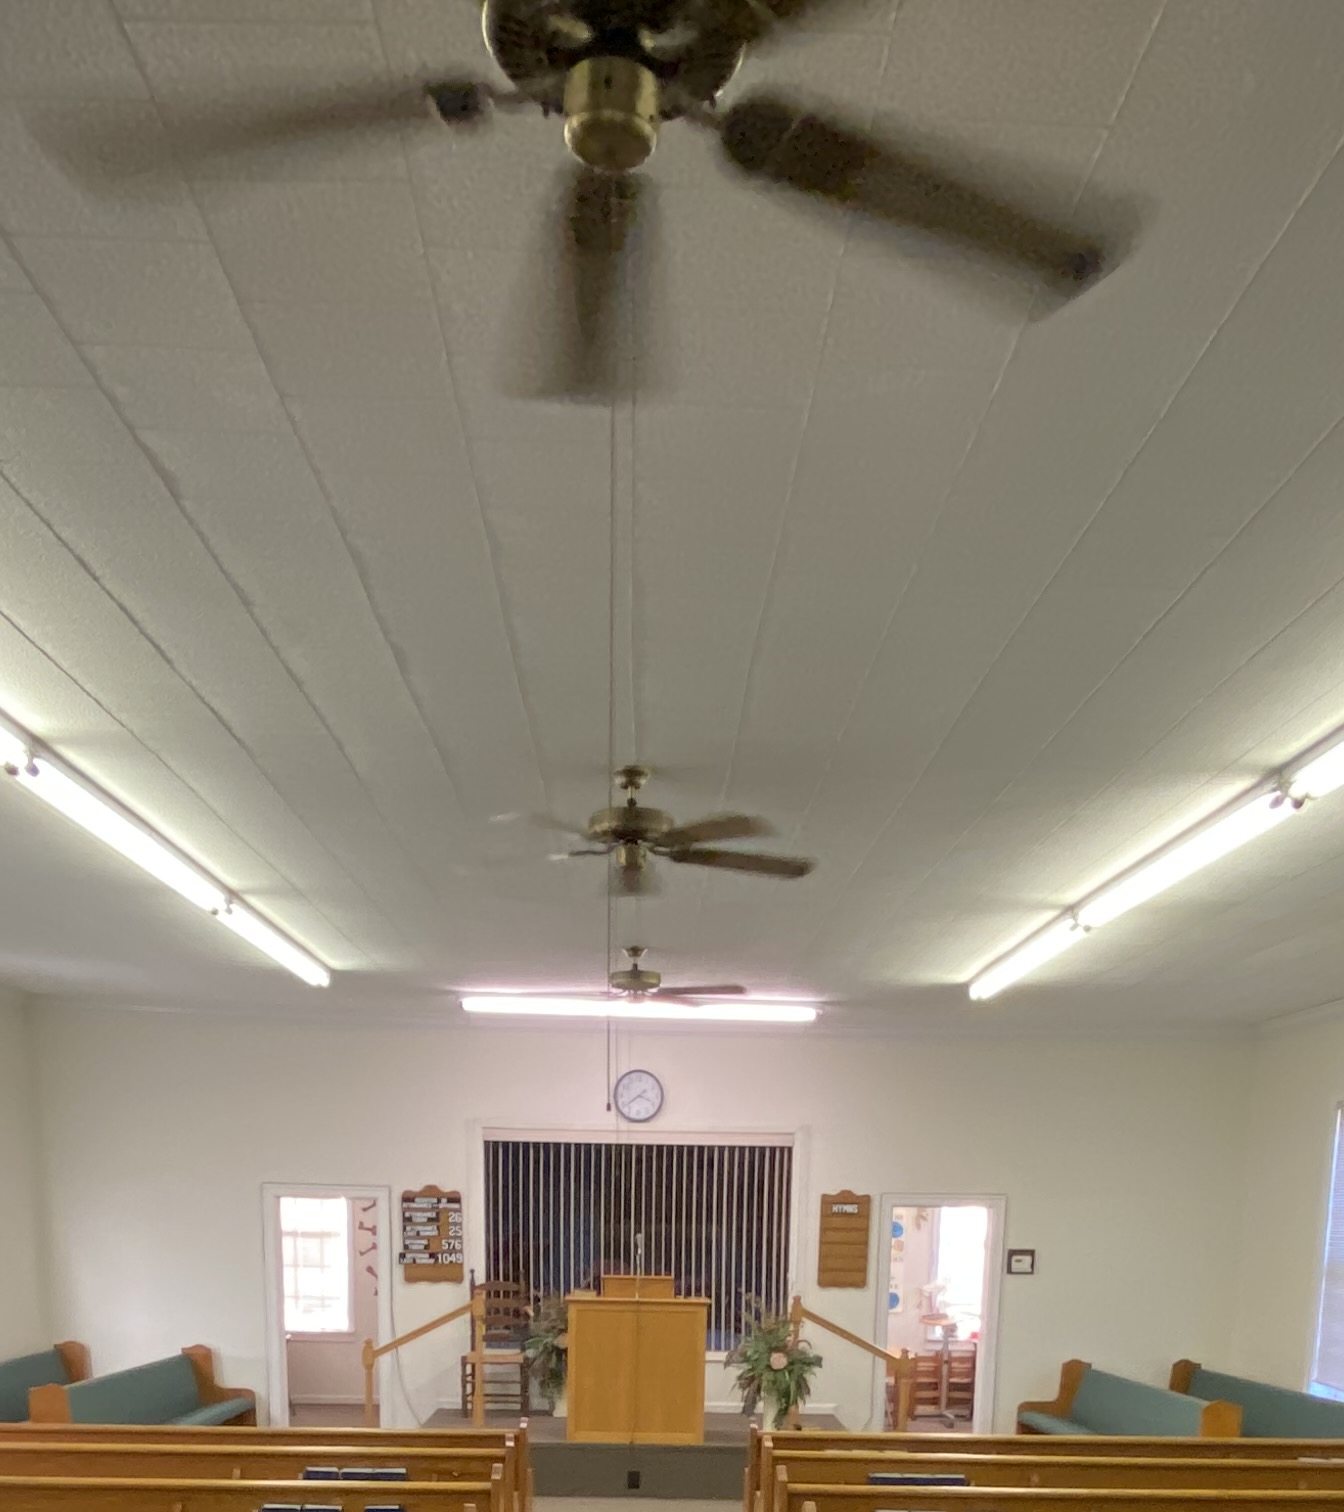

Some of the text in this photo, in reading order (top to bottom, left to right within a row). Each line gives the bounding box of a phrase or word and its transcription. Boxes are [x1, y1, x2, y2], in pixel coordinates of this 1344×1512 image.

[448, 1212, 462, 1223] 26
[448, 1226, 462, 1236] 25
[441, 1239, 461, 1250] 576
[437, 1252, 463, 1264] 1049
